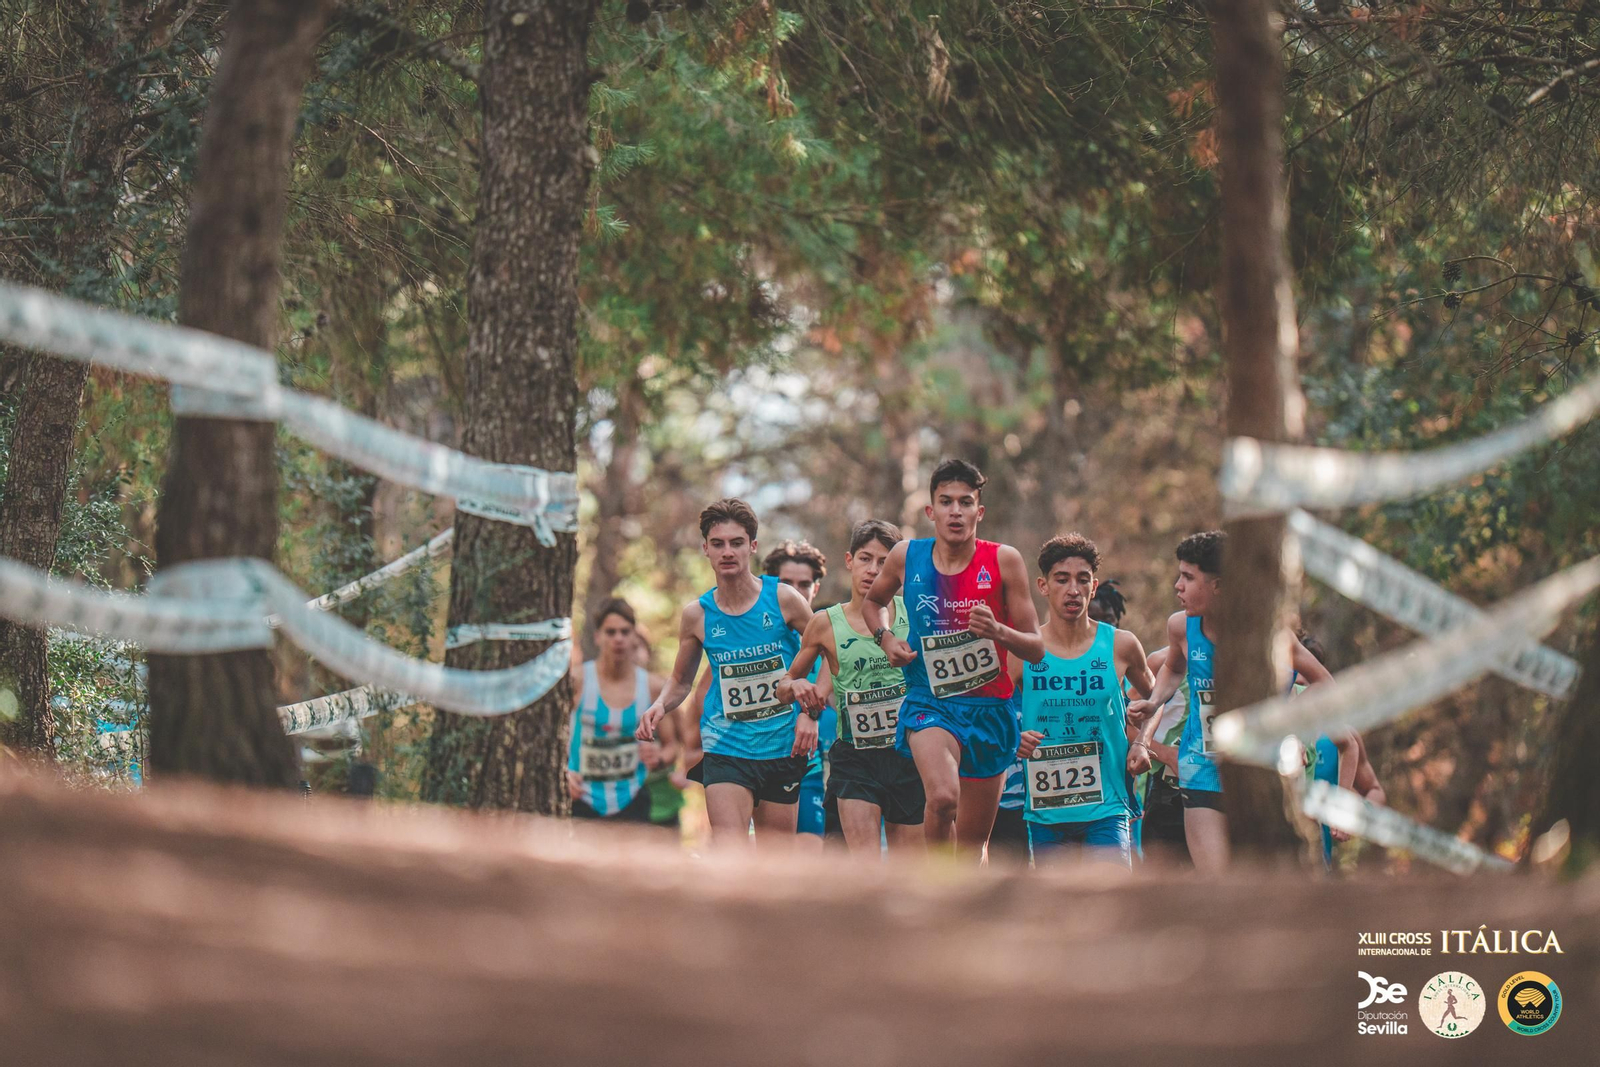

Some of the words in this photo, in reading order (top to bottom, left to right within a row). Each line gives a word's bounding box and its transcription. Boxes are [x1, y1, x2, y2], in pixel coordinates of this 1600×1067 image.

[938, 632, 972, 646] ITÁLICA
[712, 640, 784, 663] TROTASIERRA
[869, 656, 888, 664] Fund
[870, 662, 893, 671] Unica
[933, 647, 994, 680] 8103
[735, 661, 769, 675] ITÁLICA
[1032, 670, 1105, 696] nerja
[863, 688, 897, 700] ITÁLICA
[1042, 698, 1096, 707] ATLETISMO
[1045, 746, 1080, 757] ITÁLICA
[1035, 766, 1096, 792] 8123
